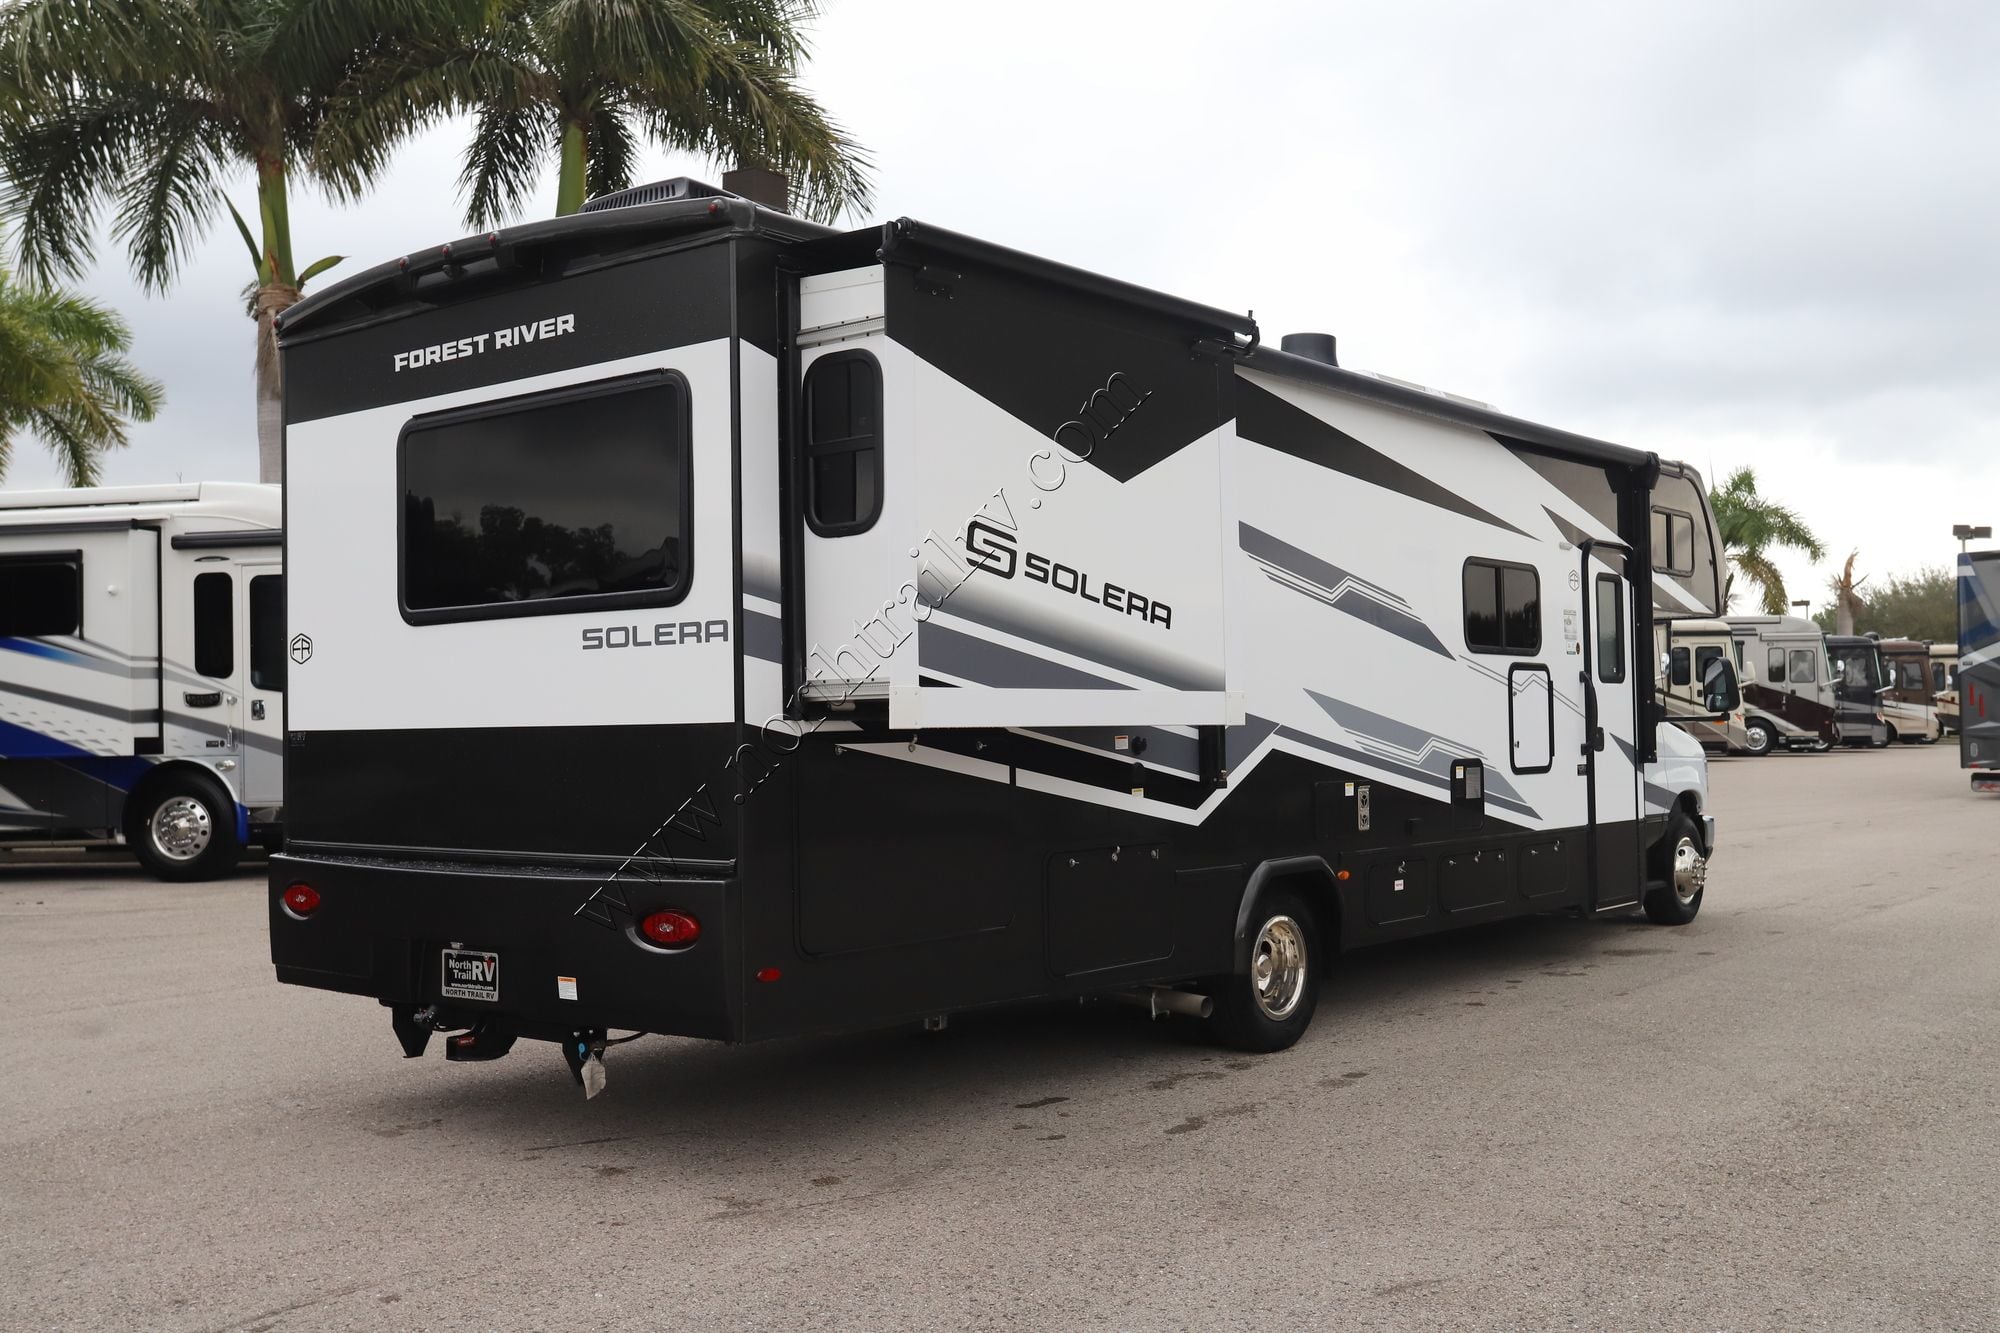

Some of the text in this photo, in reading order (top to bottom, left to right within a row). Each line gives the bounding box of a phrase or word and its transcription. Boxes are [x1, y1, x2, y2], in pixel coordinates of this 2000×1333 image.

[393, 313, 576, 373] FOREST RIVER
[1024, 552, 1172, 630] SOLERA
[582, 619, 729, 650] SOLERA
[448, 958, 472, 970] North
[452, 968, 472, 980] Trail
[471, 960, 496, 982] RV
[445, 988, 495, 1000] NORTH TRAIL RV
